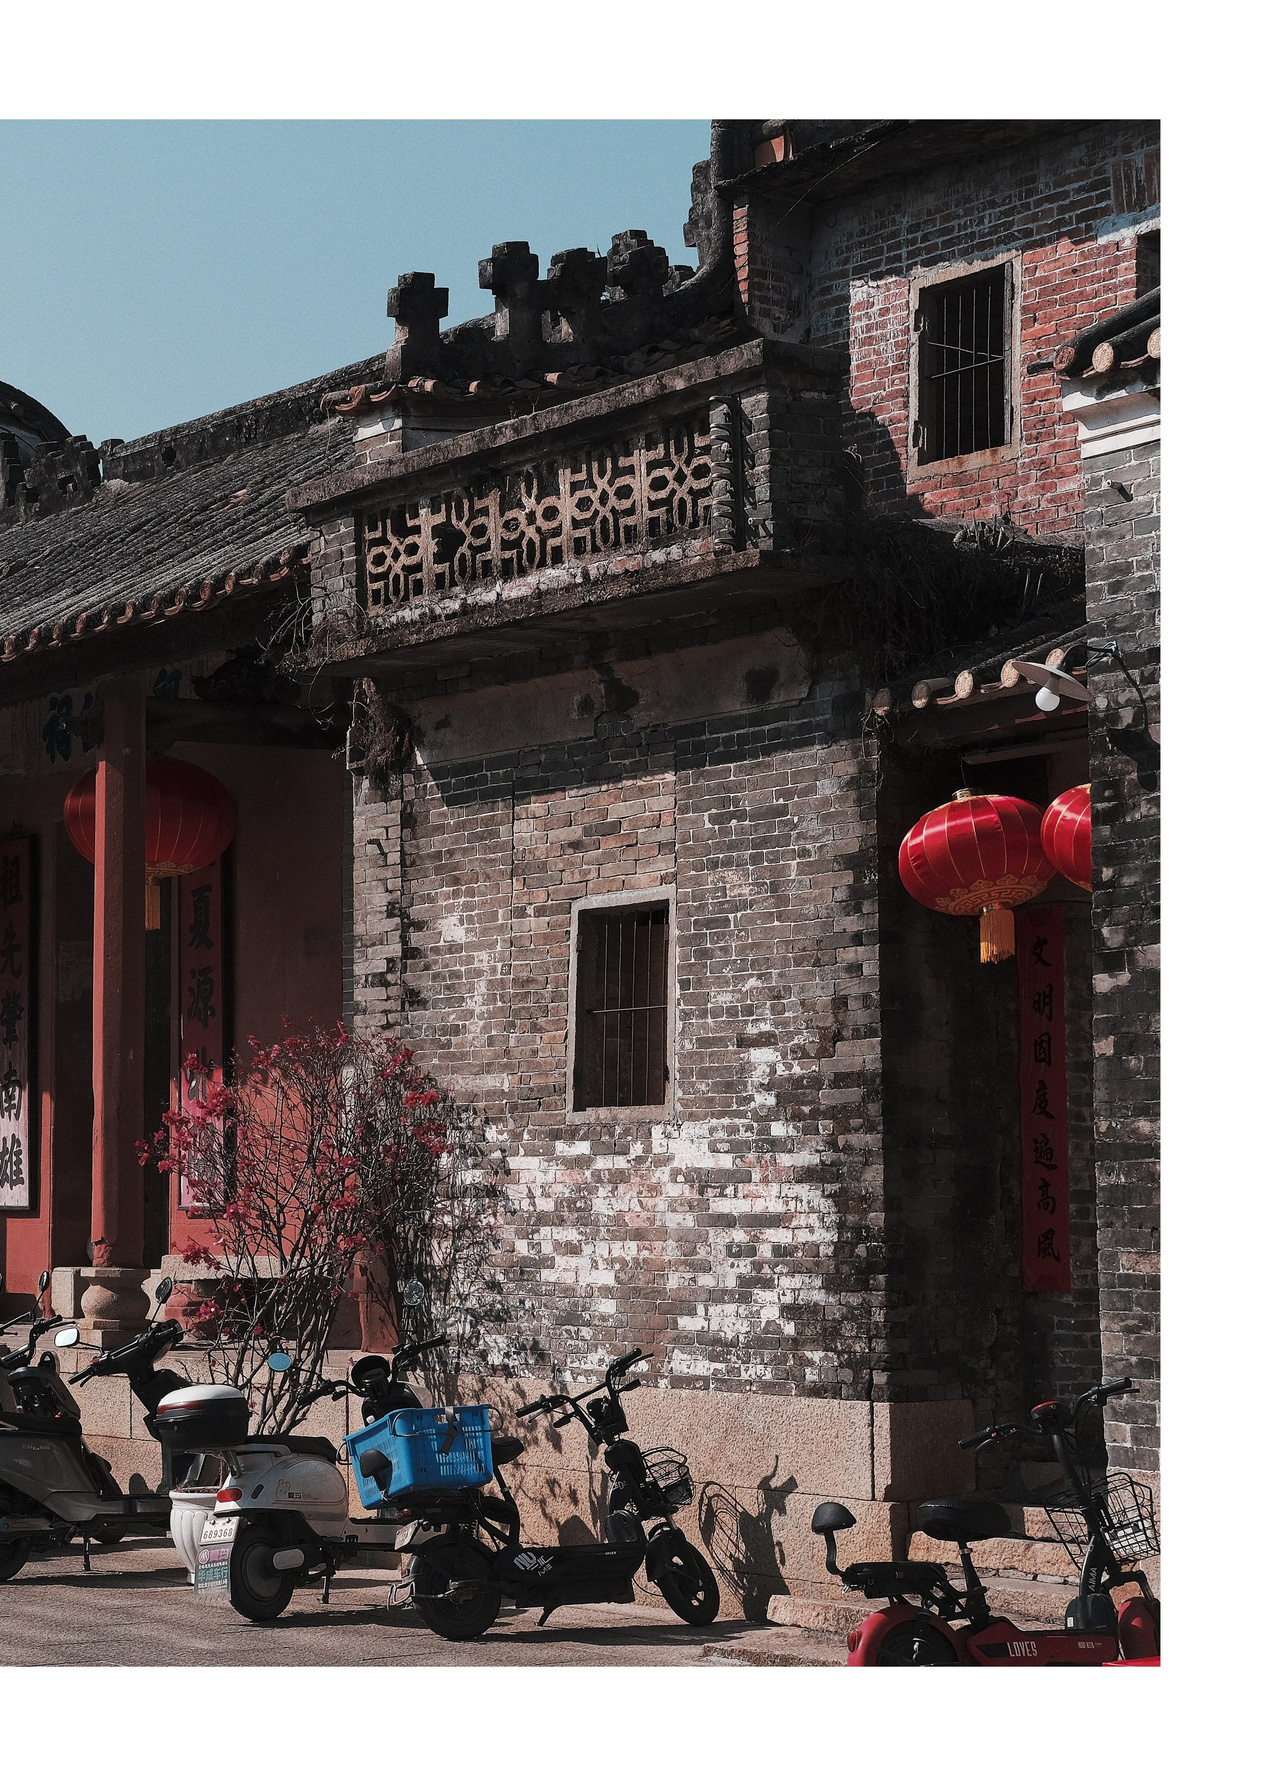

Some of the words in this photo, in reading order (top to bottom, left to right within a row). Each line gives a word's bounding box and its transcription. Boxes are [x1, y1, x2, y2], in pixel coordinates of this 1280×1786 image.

[203, 1527, 234, 1540] 689368
[1088, 1567, 1098, 1592] AIMA
[1006, 1641, 1038, 1657] LOVES
